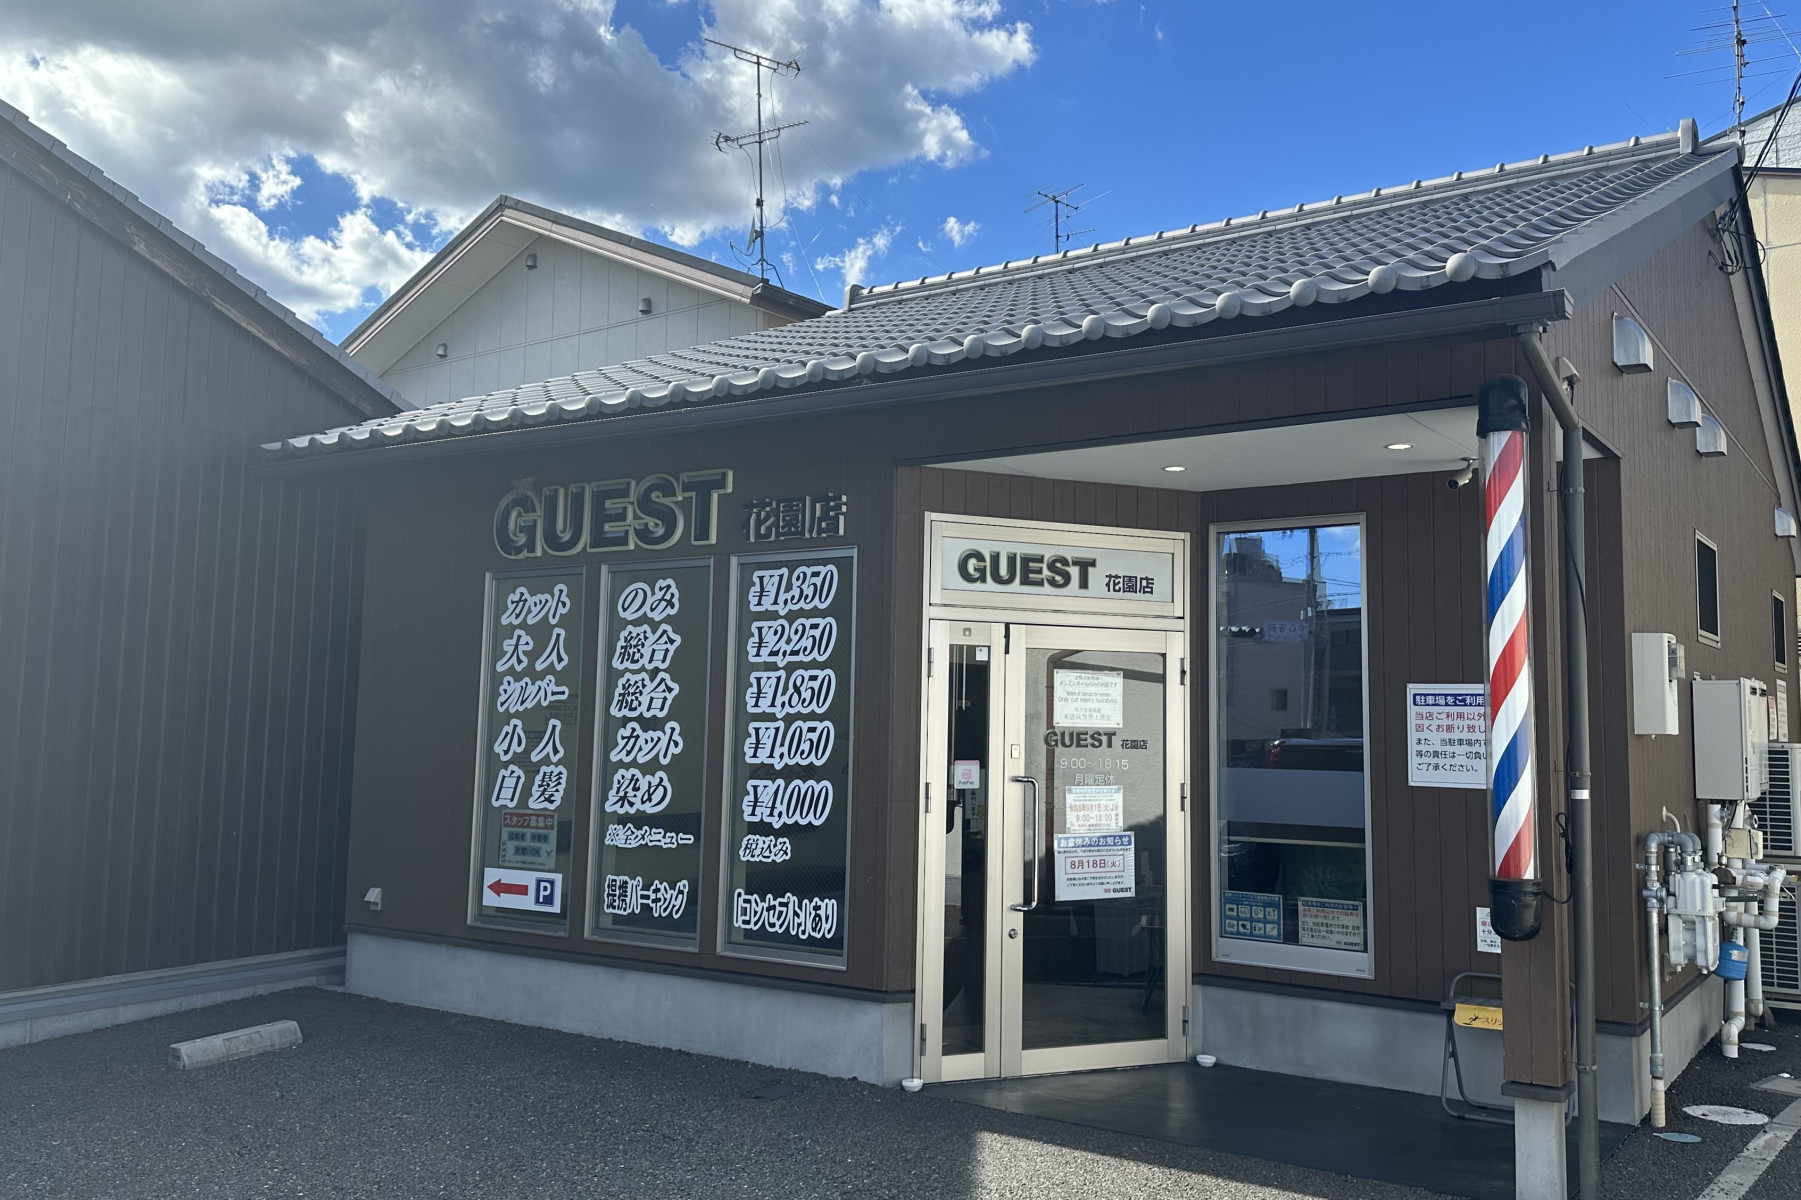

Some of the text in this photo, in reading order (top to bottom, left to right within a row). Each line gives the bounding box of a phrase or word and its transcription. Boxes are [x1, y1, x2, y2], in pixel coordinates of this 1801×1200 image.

[494, 469, 847, 559] GUEST 花園店
[749, 564, 839, 615] ¥1,350
[957, 548, 1155, 595] GUEST 花園店
[501, 584, 570, 625] カット
[617, 579, 680, 621] のみ
[612, 624, 681, 670] 総合
[747, 616, 837, 667] ¥2,250
[497, 675, 568, 713] シルバー
[611, 672, 680, 717] 総合
[746, 669, 836, 718] ¥1,850
[609, 721, 683, 765] カット
[744, 720, 834, 770] ¥1,050
[1044, 730, 1148, 750] GUEST 花園店
[1074, 773, 1116, 785] 月曜定休
[1416, 763, 1478, 772] ご了承ください。
[604, 768, 673, 813] 染め
[742, 779, 833, 829] ¥4,000
[739, 834, 791, 863] 税込み
[1060, 836, 1130, 848] お盆休みのお知らせ
[539, 881, 552, 903] P
[604, 874, 689, 919] 提携パーキング
[733, 888, 838, 939] 「コンセプト」あり
